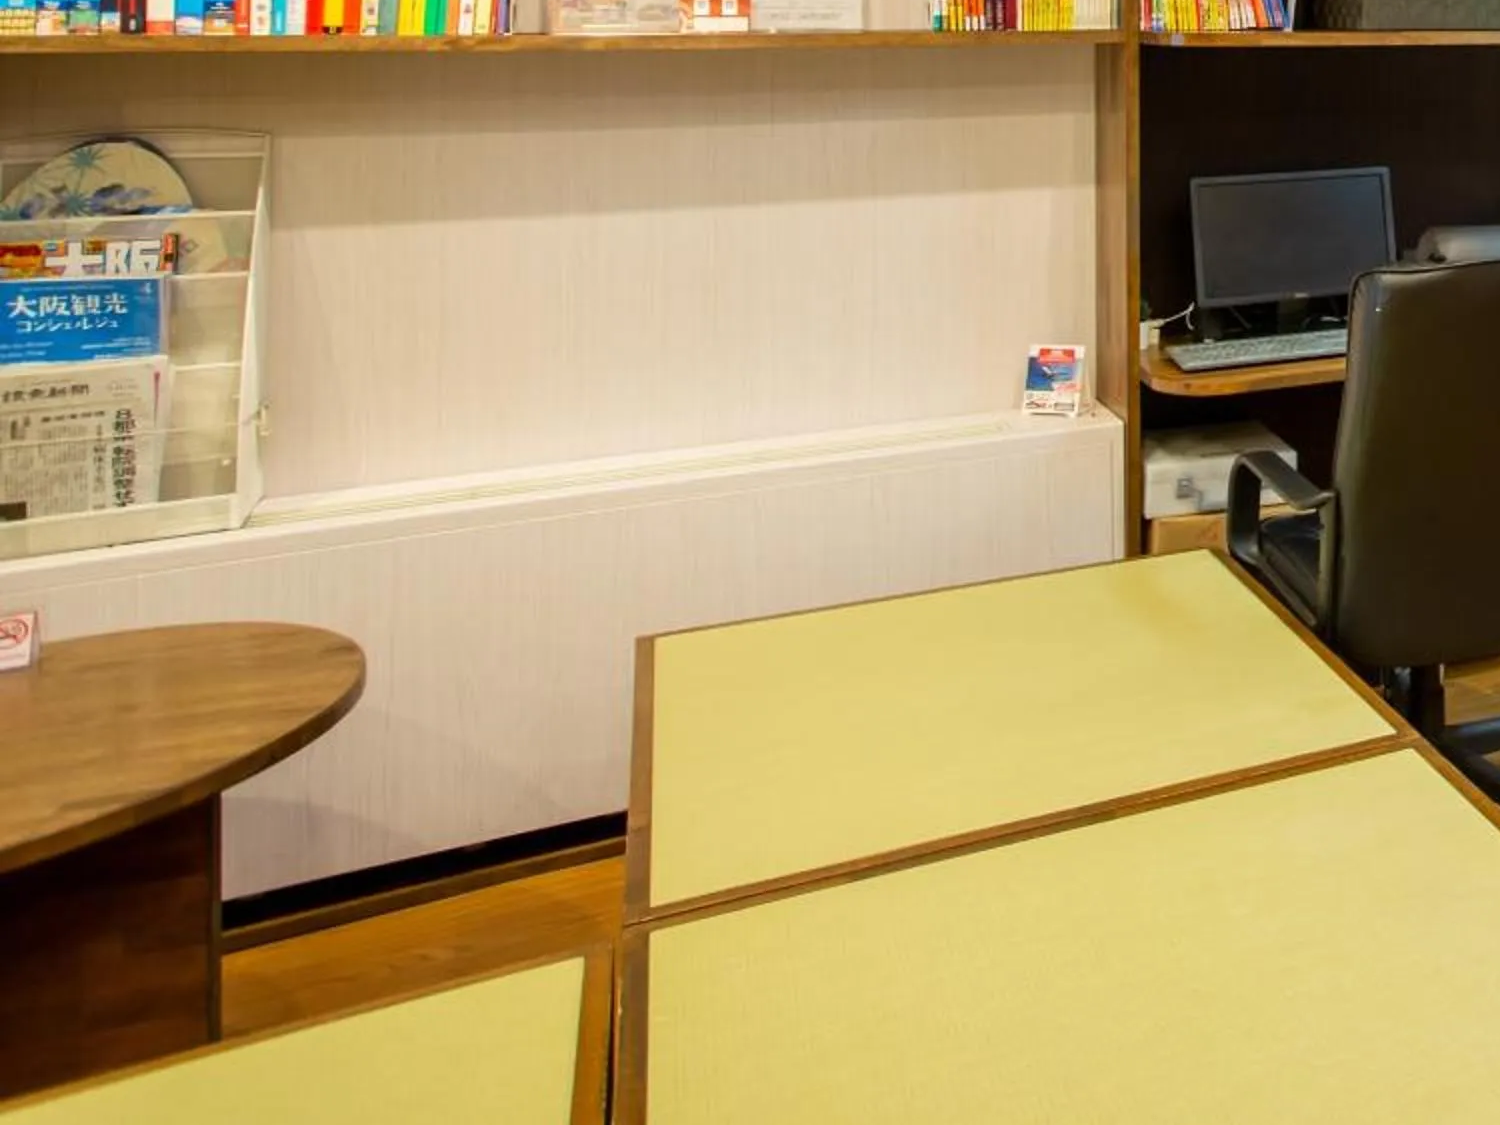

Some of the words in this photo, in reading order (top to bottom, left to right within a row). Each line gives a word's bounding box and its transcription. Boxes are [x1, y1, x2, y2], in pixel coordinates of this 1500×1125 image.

[6, 293, 128, 318] 大阪観光
[16, 317, 119, 334] コンシェルジュ
